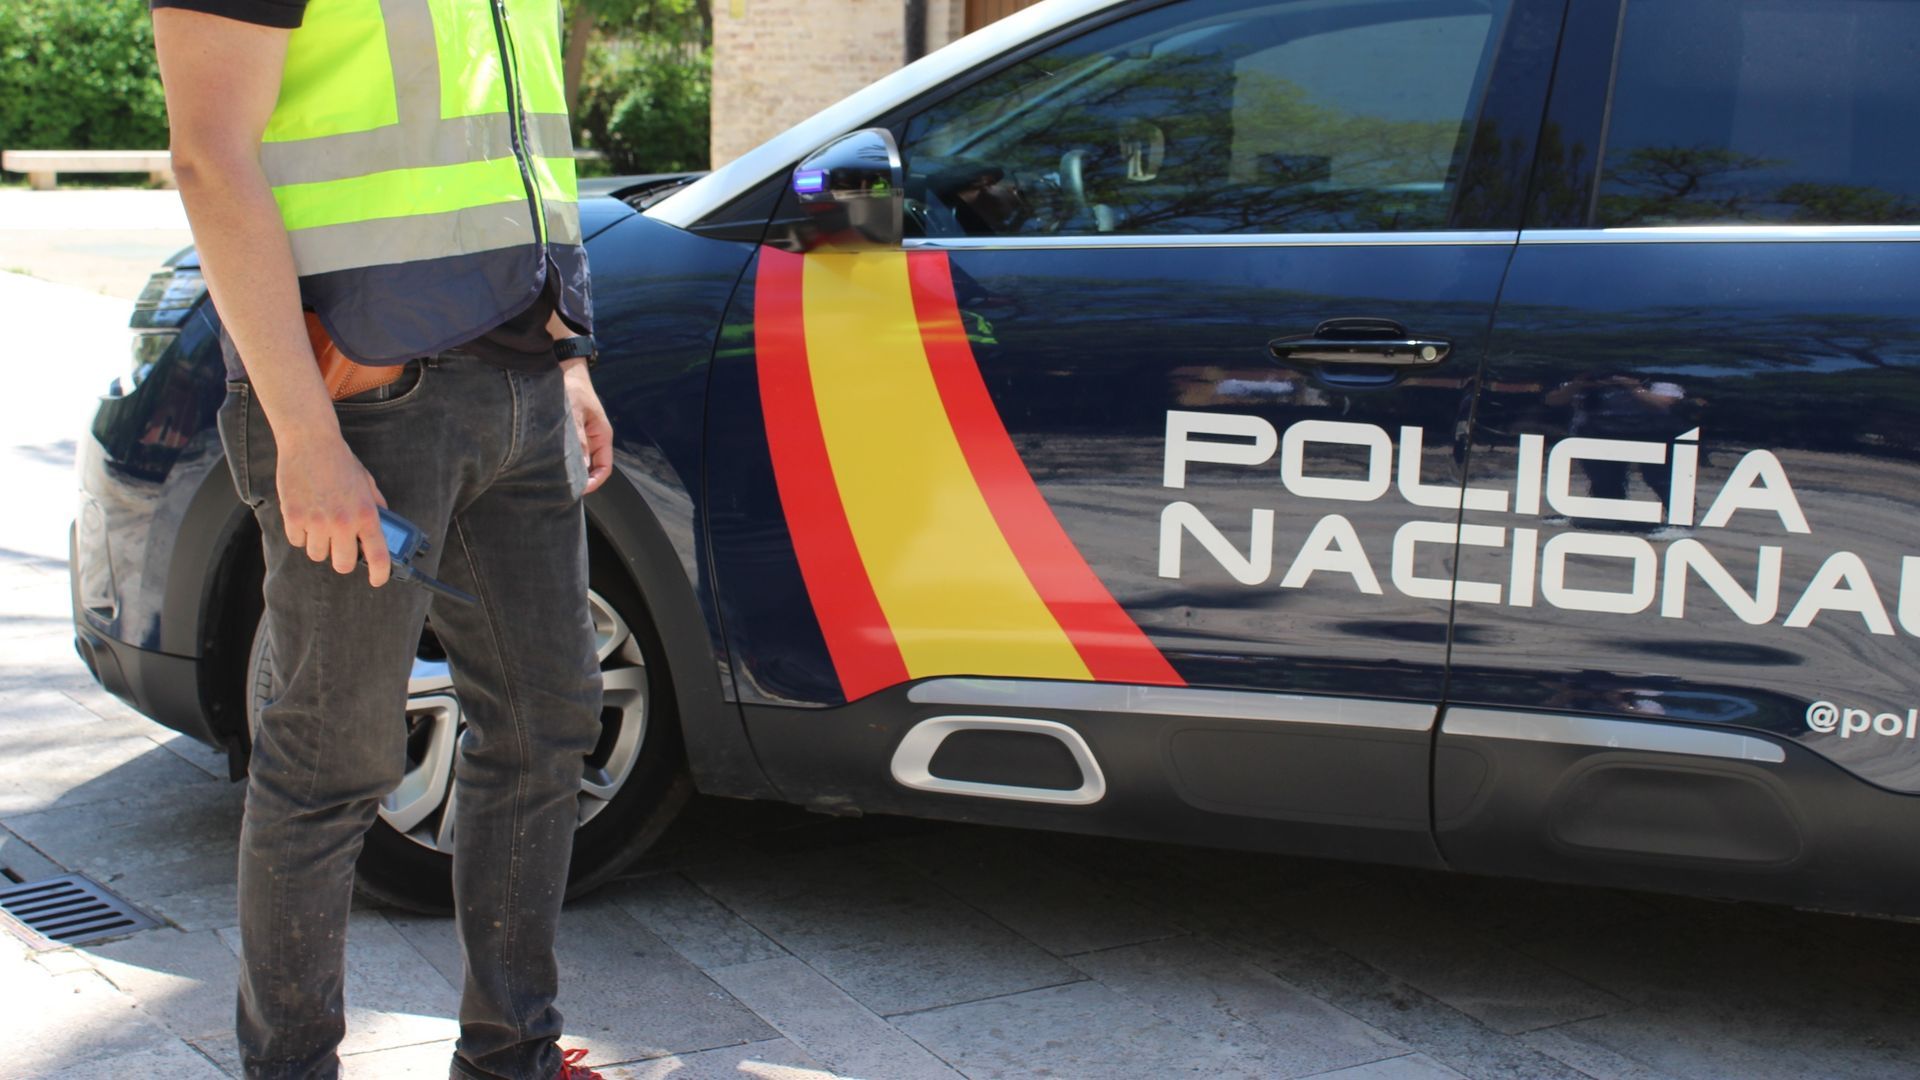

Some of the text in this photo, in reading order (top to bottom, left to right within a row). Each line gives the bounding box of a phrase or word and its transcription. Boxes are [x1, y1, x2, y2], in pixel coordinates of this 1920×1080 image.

[1163, 410, 1811, 534] POLICÍA
[1158, 502, 1920, 639] NACIONA
[1806, 701, 1918, 738] @pol
